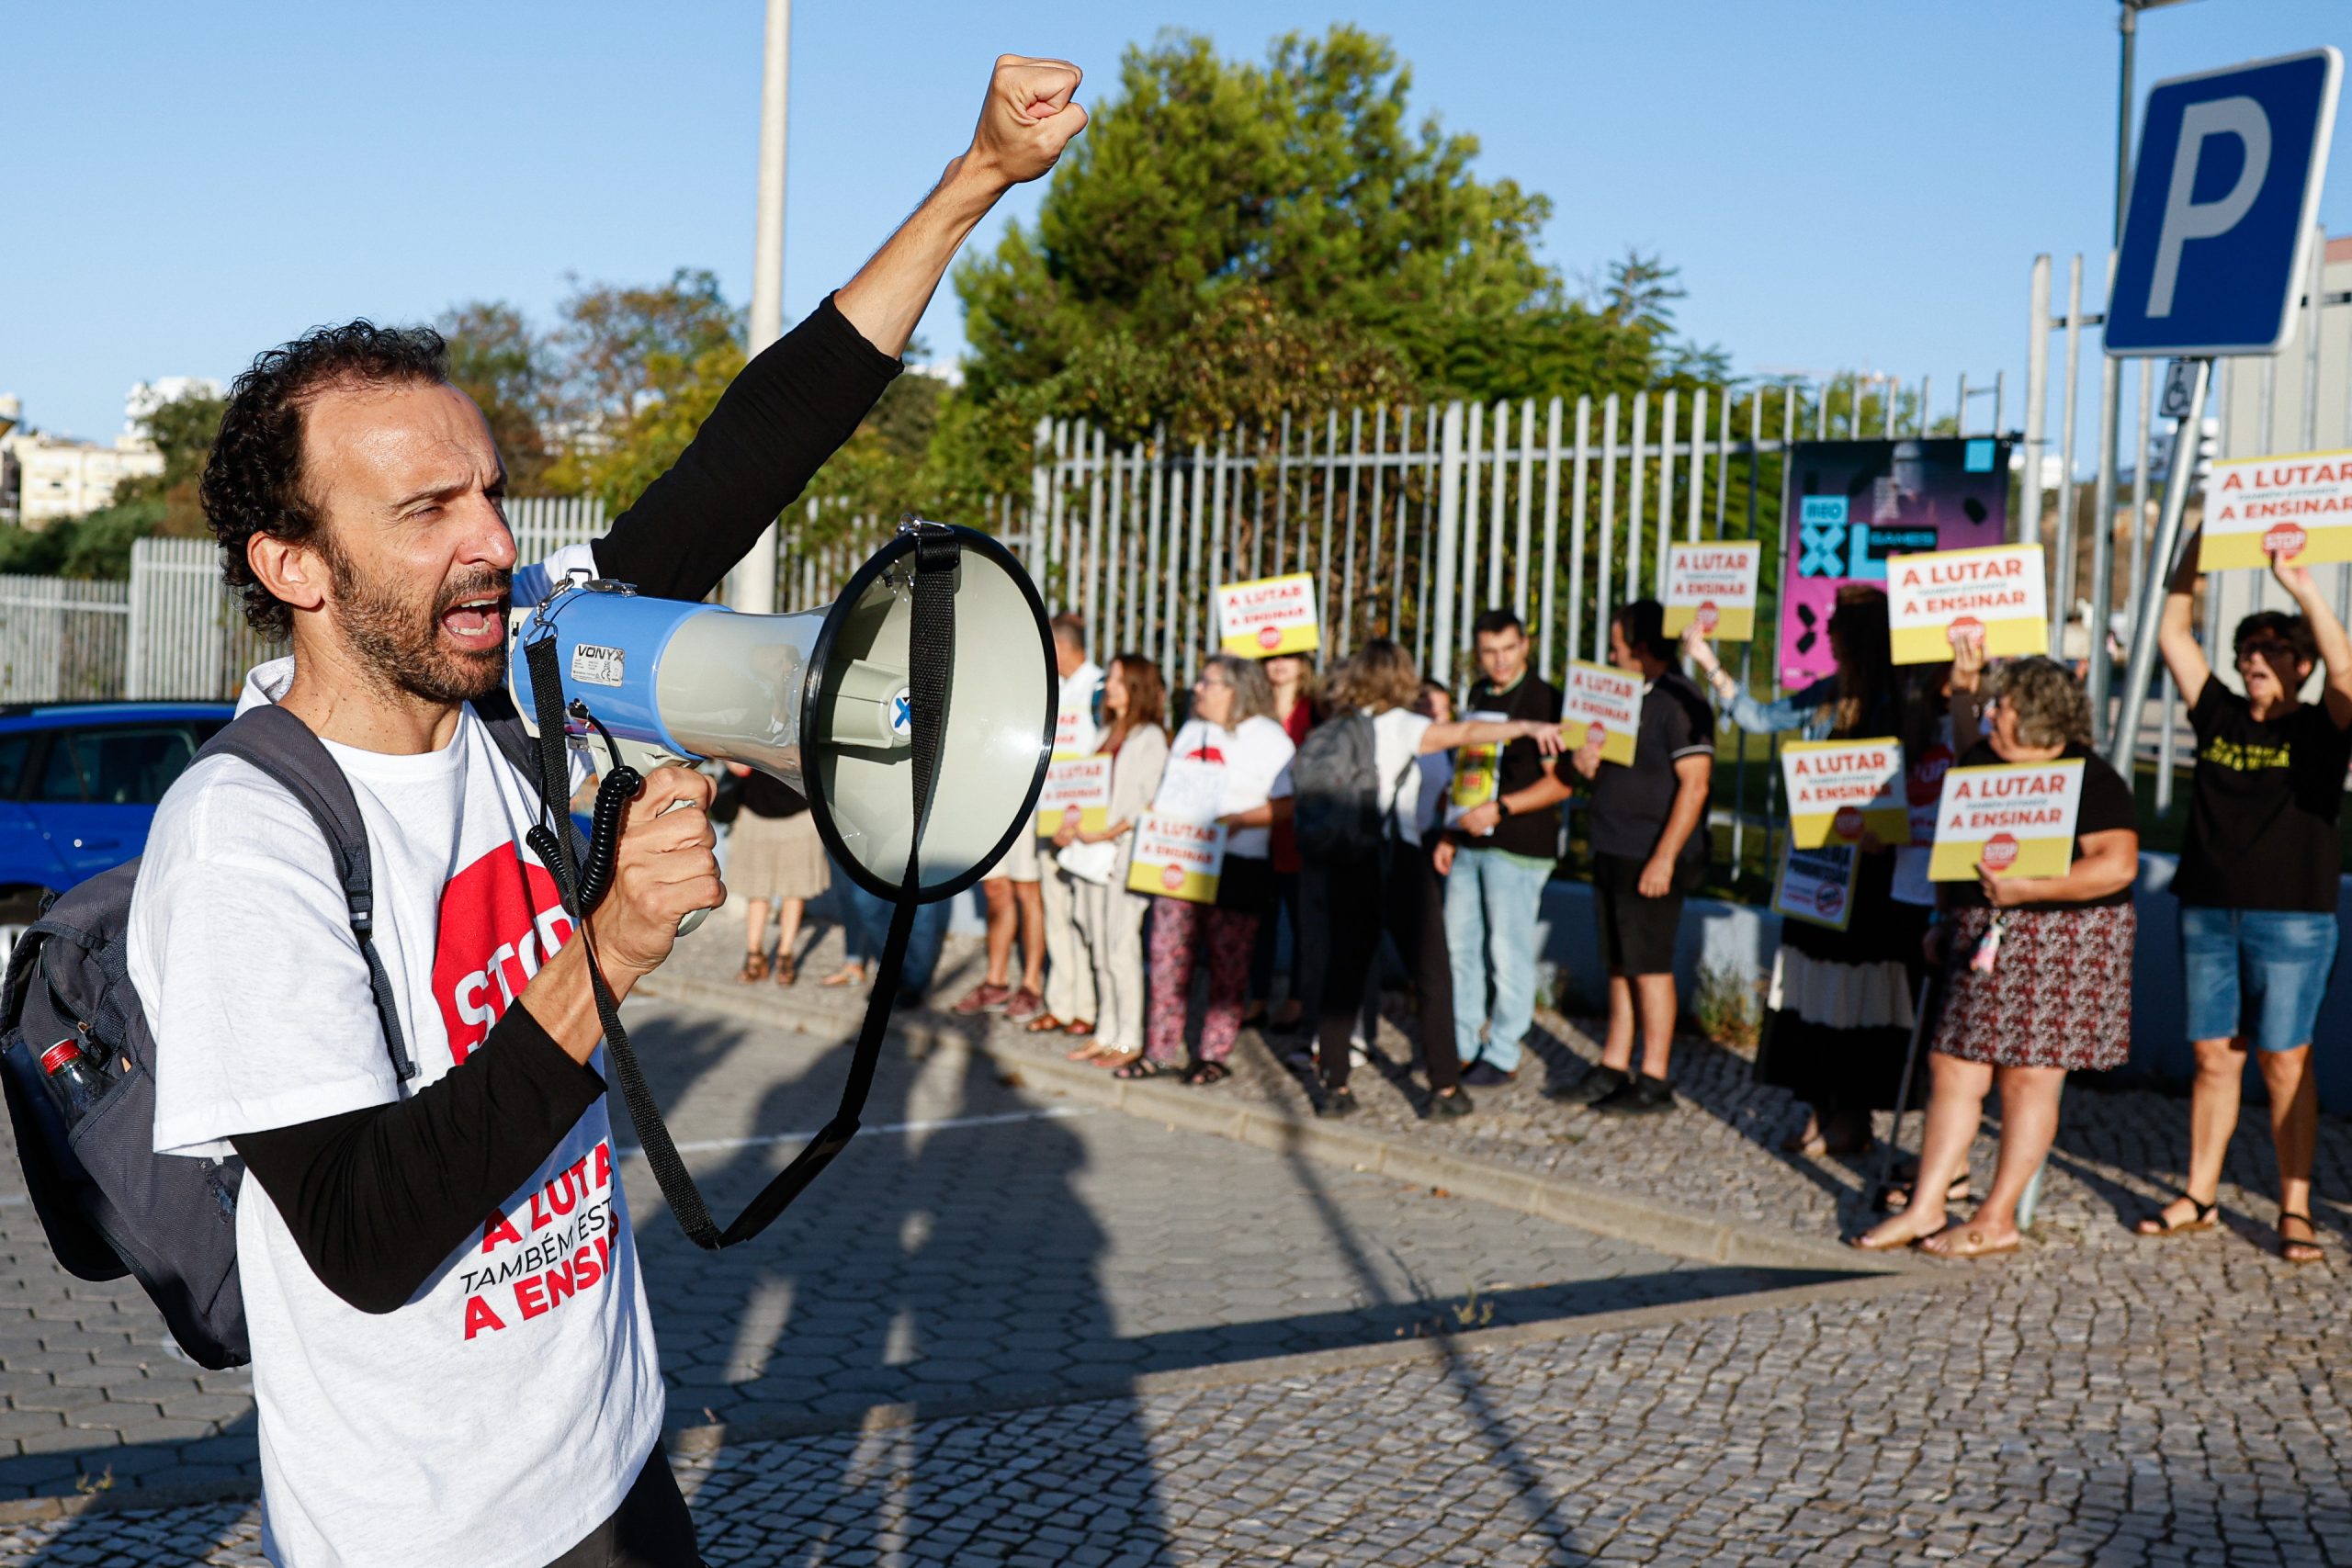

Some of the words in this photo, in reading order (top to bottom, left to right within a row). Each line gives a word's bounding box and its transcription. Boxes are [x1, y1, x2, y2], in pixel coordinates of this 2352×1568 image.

[2145, 96, 2272, 319] P
[2222, 472, 2244, 491] A
[2255, 463, 2352, 488] LUTAR
[2219, 505, 2236, 521] A
[2245, 496, 2352, 519] ENSINAR
[1676, 553, 1688, 569] A
[1692, 553, 1748, 570] LUTAR
[1903, 568, 1921, 587] A
[1931, 558, 2023, 583] LUTAR
[1904, 600, 1918, 615] A
[1927, 590, 2027, 613] ENSINAR
[578, 645, 624, 661] VONYX
[1574, 671, 1583, 685] A
[1795, 758, 1810, 775] A
[1815, 751, 1886, 773] LUTAR
[1799, 788, 1811, 802] A
[1815, 783, 1892, 802] ENSINAR
[1954, 781, 1971, 800] A
[1981, 773, 2067, 797] LUTAR
[1949, 814, 1963, 829] A
[1971, 808, 2063, 829] ENSINAR
[529, 1142, 611, 1232] LUTA
[460, 1225, 574, 1294] TAMBÉM
[464, 1294, 507, 1341] A
